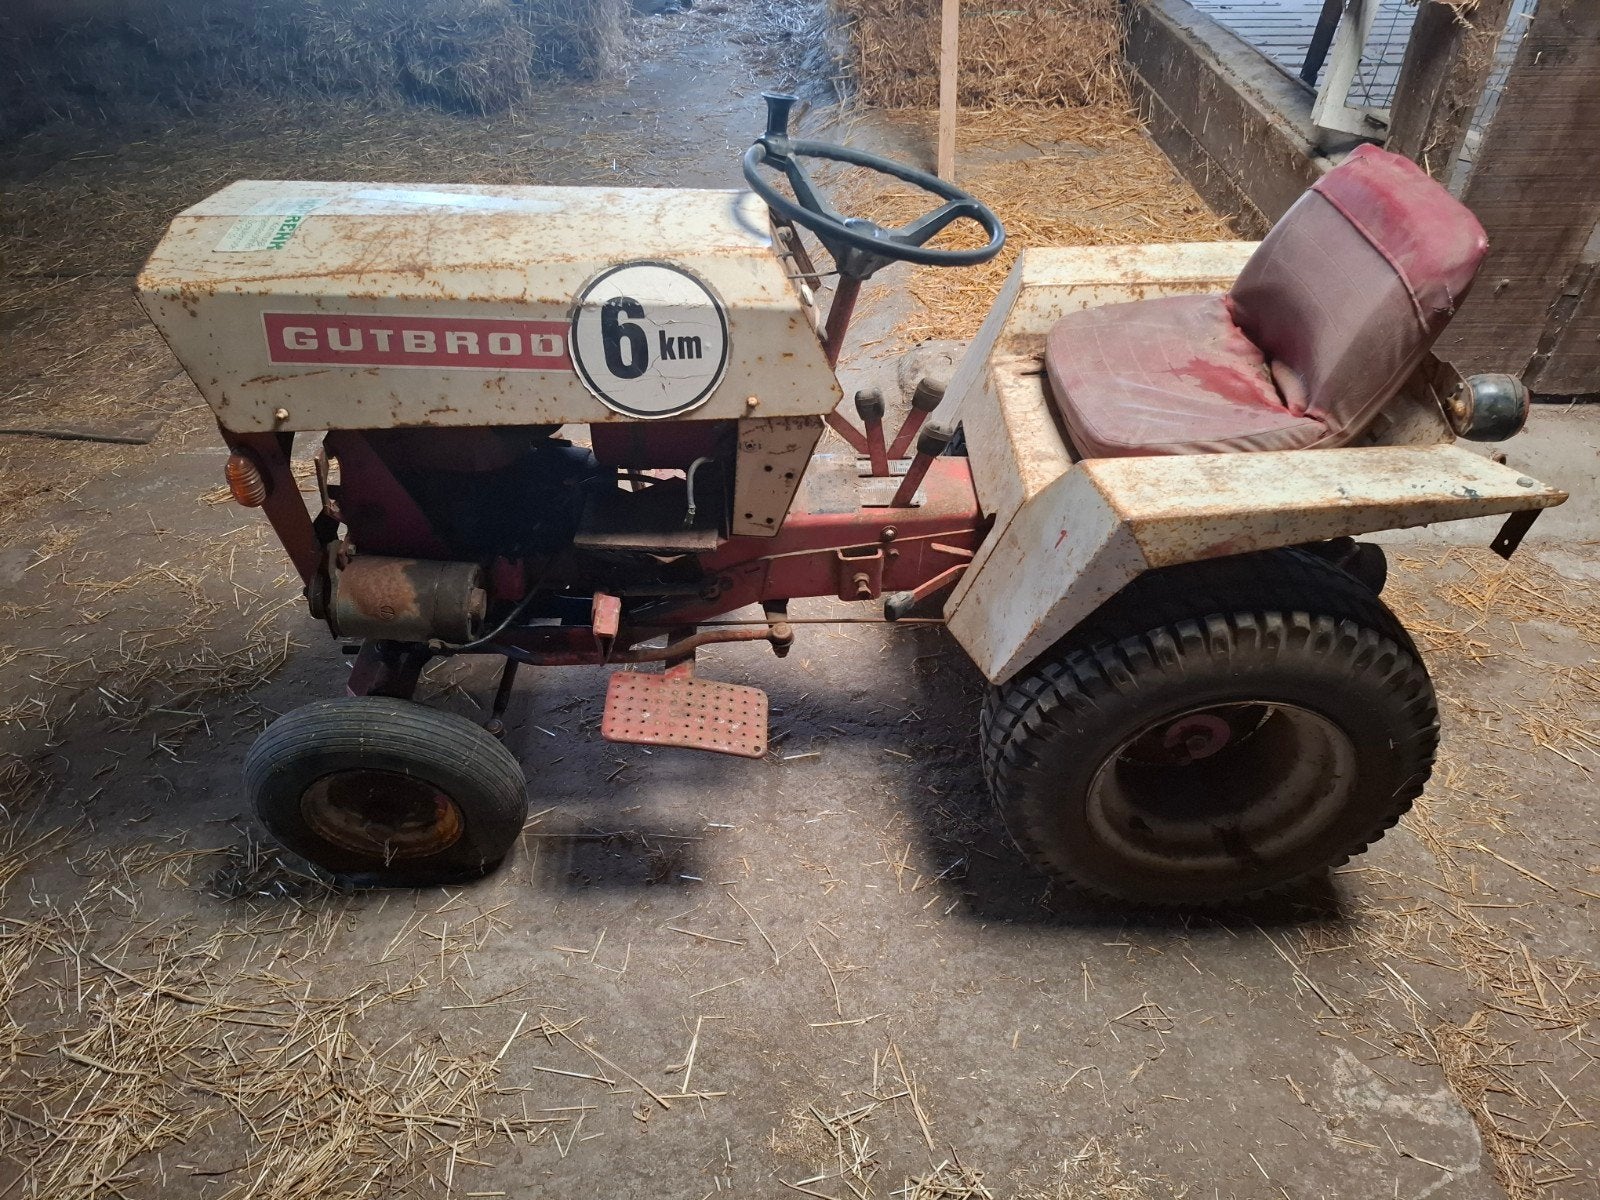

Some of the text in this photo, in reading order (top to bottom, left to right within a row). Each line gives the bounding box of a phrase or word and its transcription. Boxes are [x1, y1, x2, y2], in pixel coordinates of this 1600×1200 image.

[282, 326, 564, 357] GUTBROD
[601, 297, 702, 379] 6 km
